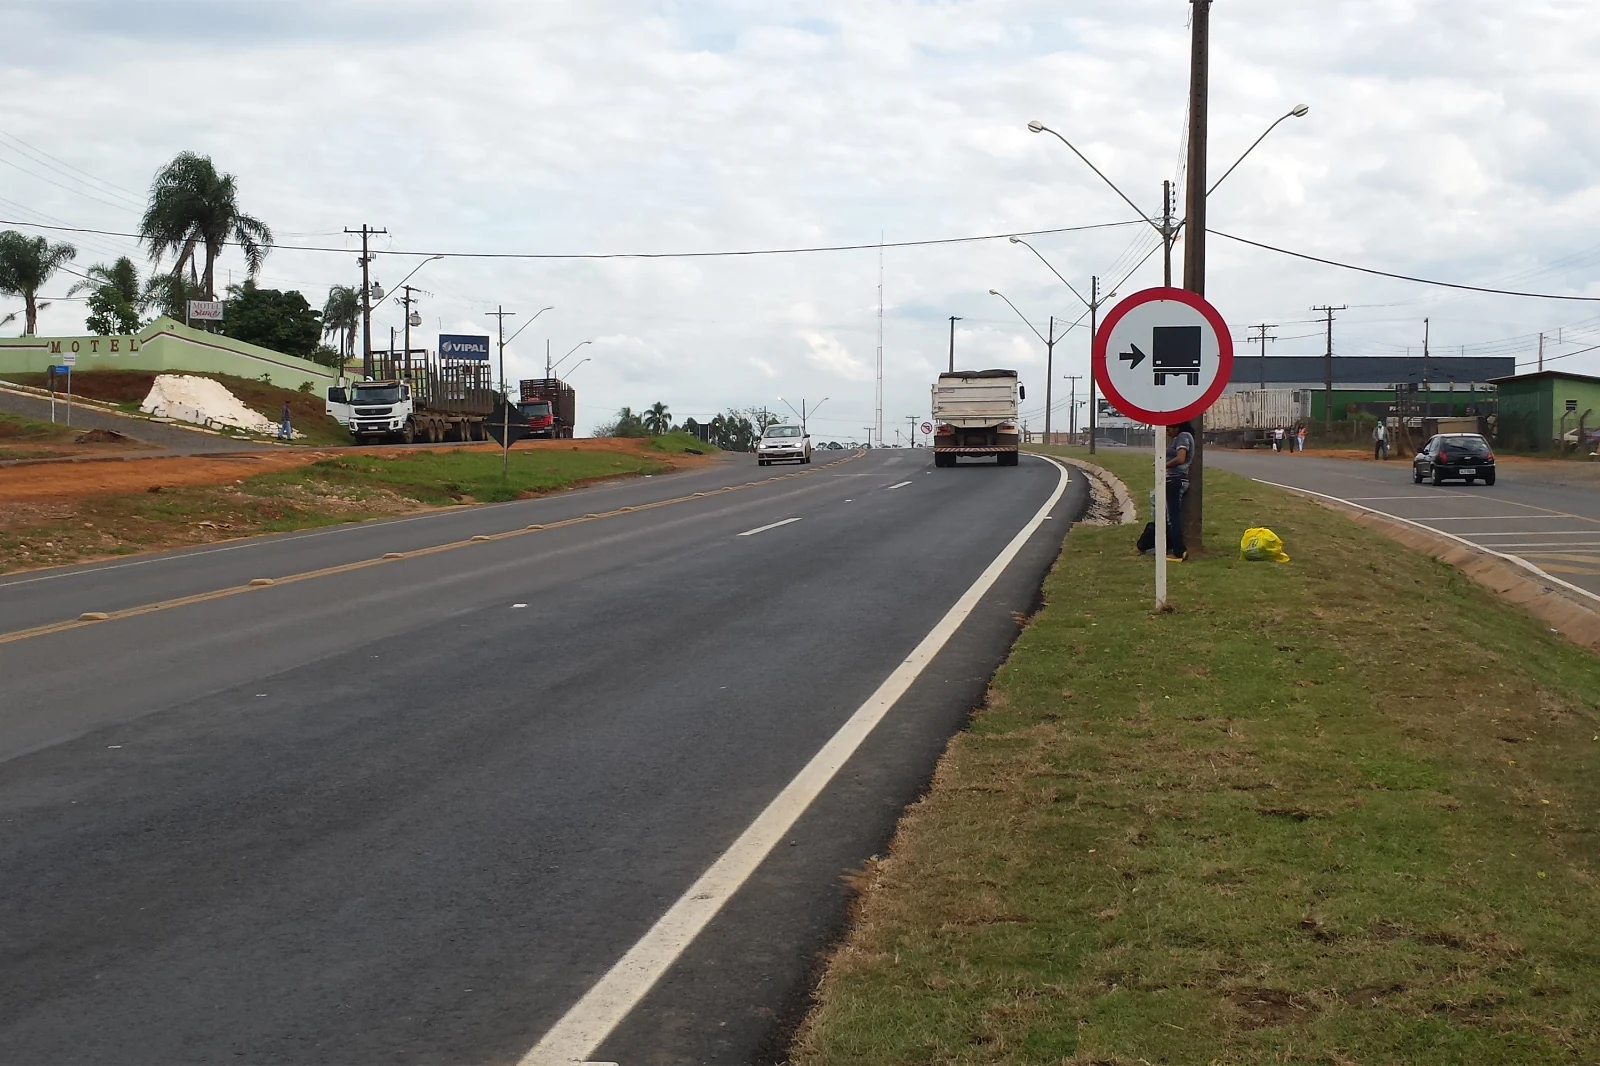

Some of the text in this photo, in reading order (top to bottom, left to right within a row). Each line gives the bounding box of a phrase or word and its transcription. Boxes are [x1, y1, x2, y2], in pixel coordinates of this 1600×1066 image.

[193, 302, 221, 310] MOTEL
[51, 339, 138, 353] MOTEL
[452, 343, 487, 353] VIPAL
